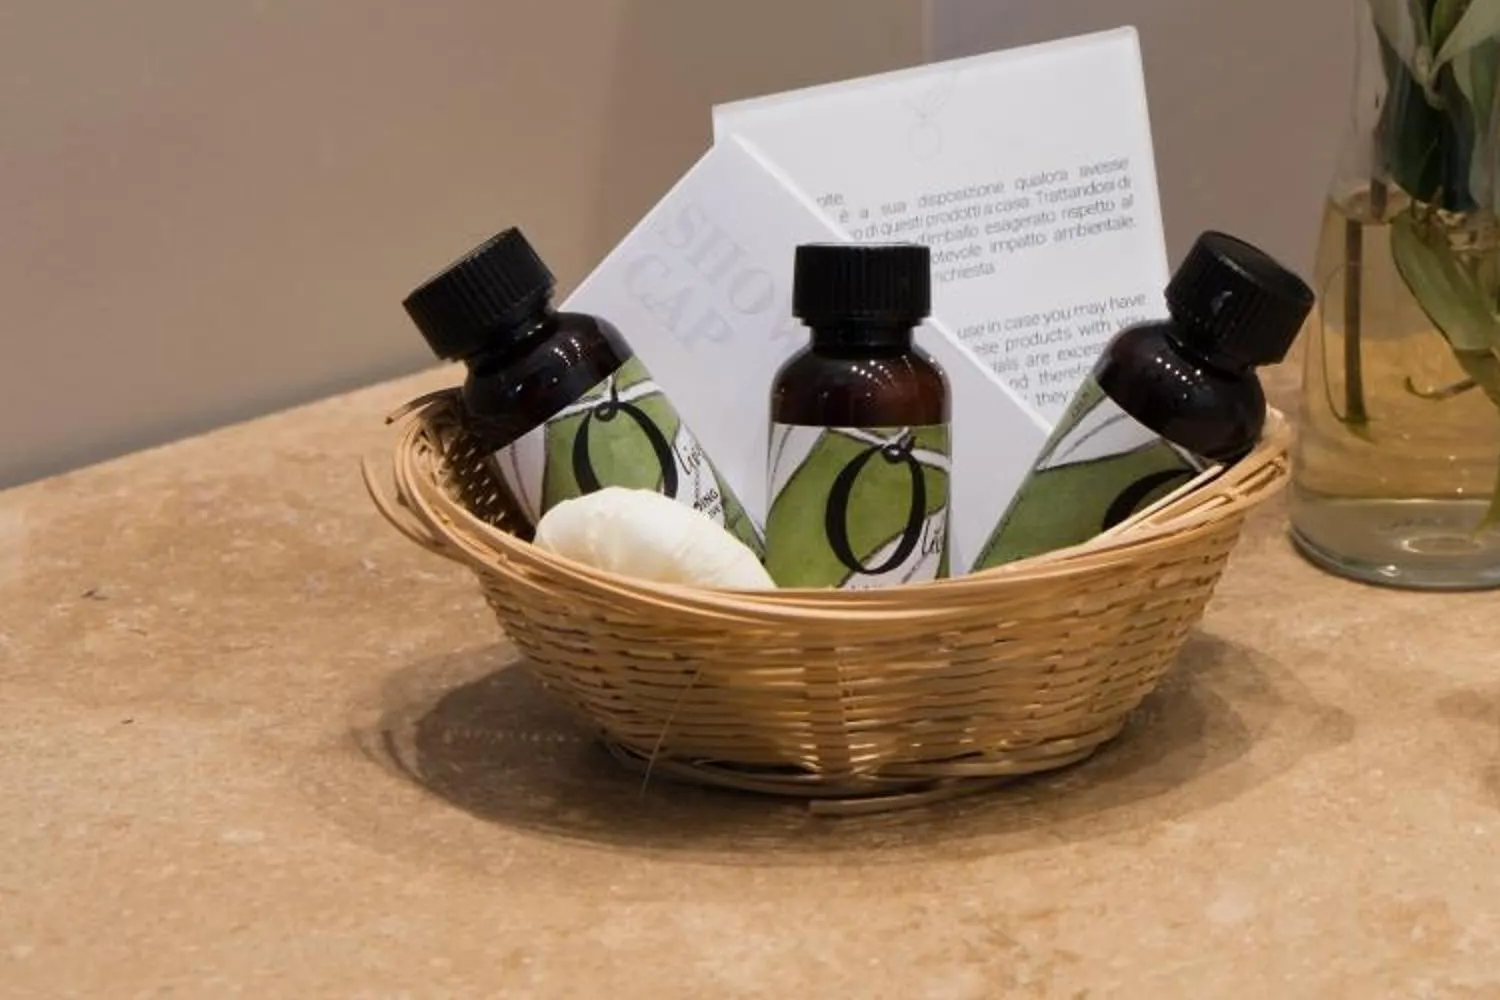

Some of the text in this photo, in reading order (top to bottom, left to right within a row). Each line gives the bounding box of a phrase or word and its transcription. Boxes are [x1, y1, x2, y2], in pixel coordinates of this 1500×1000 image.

[1004, 313, 1041, 332] case
[1041, 307, 1073, 326] you
[1109, 293, 1148, 312] have
[1004, 328, 1073, 353] products
[1077, 318, 1112, 338] with
